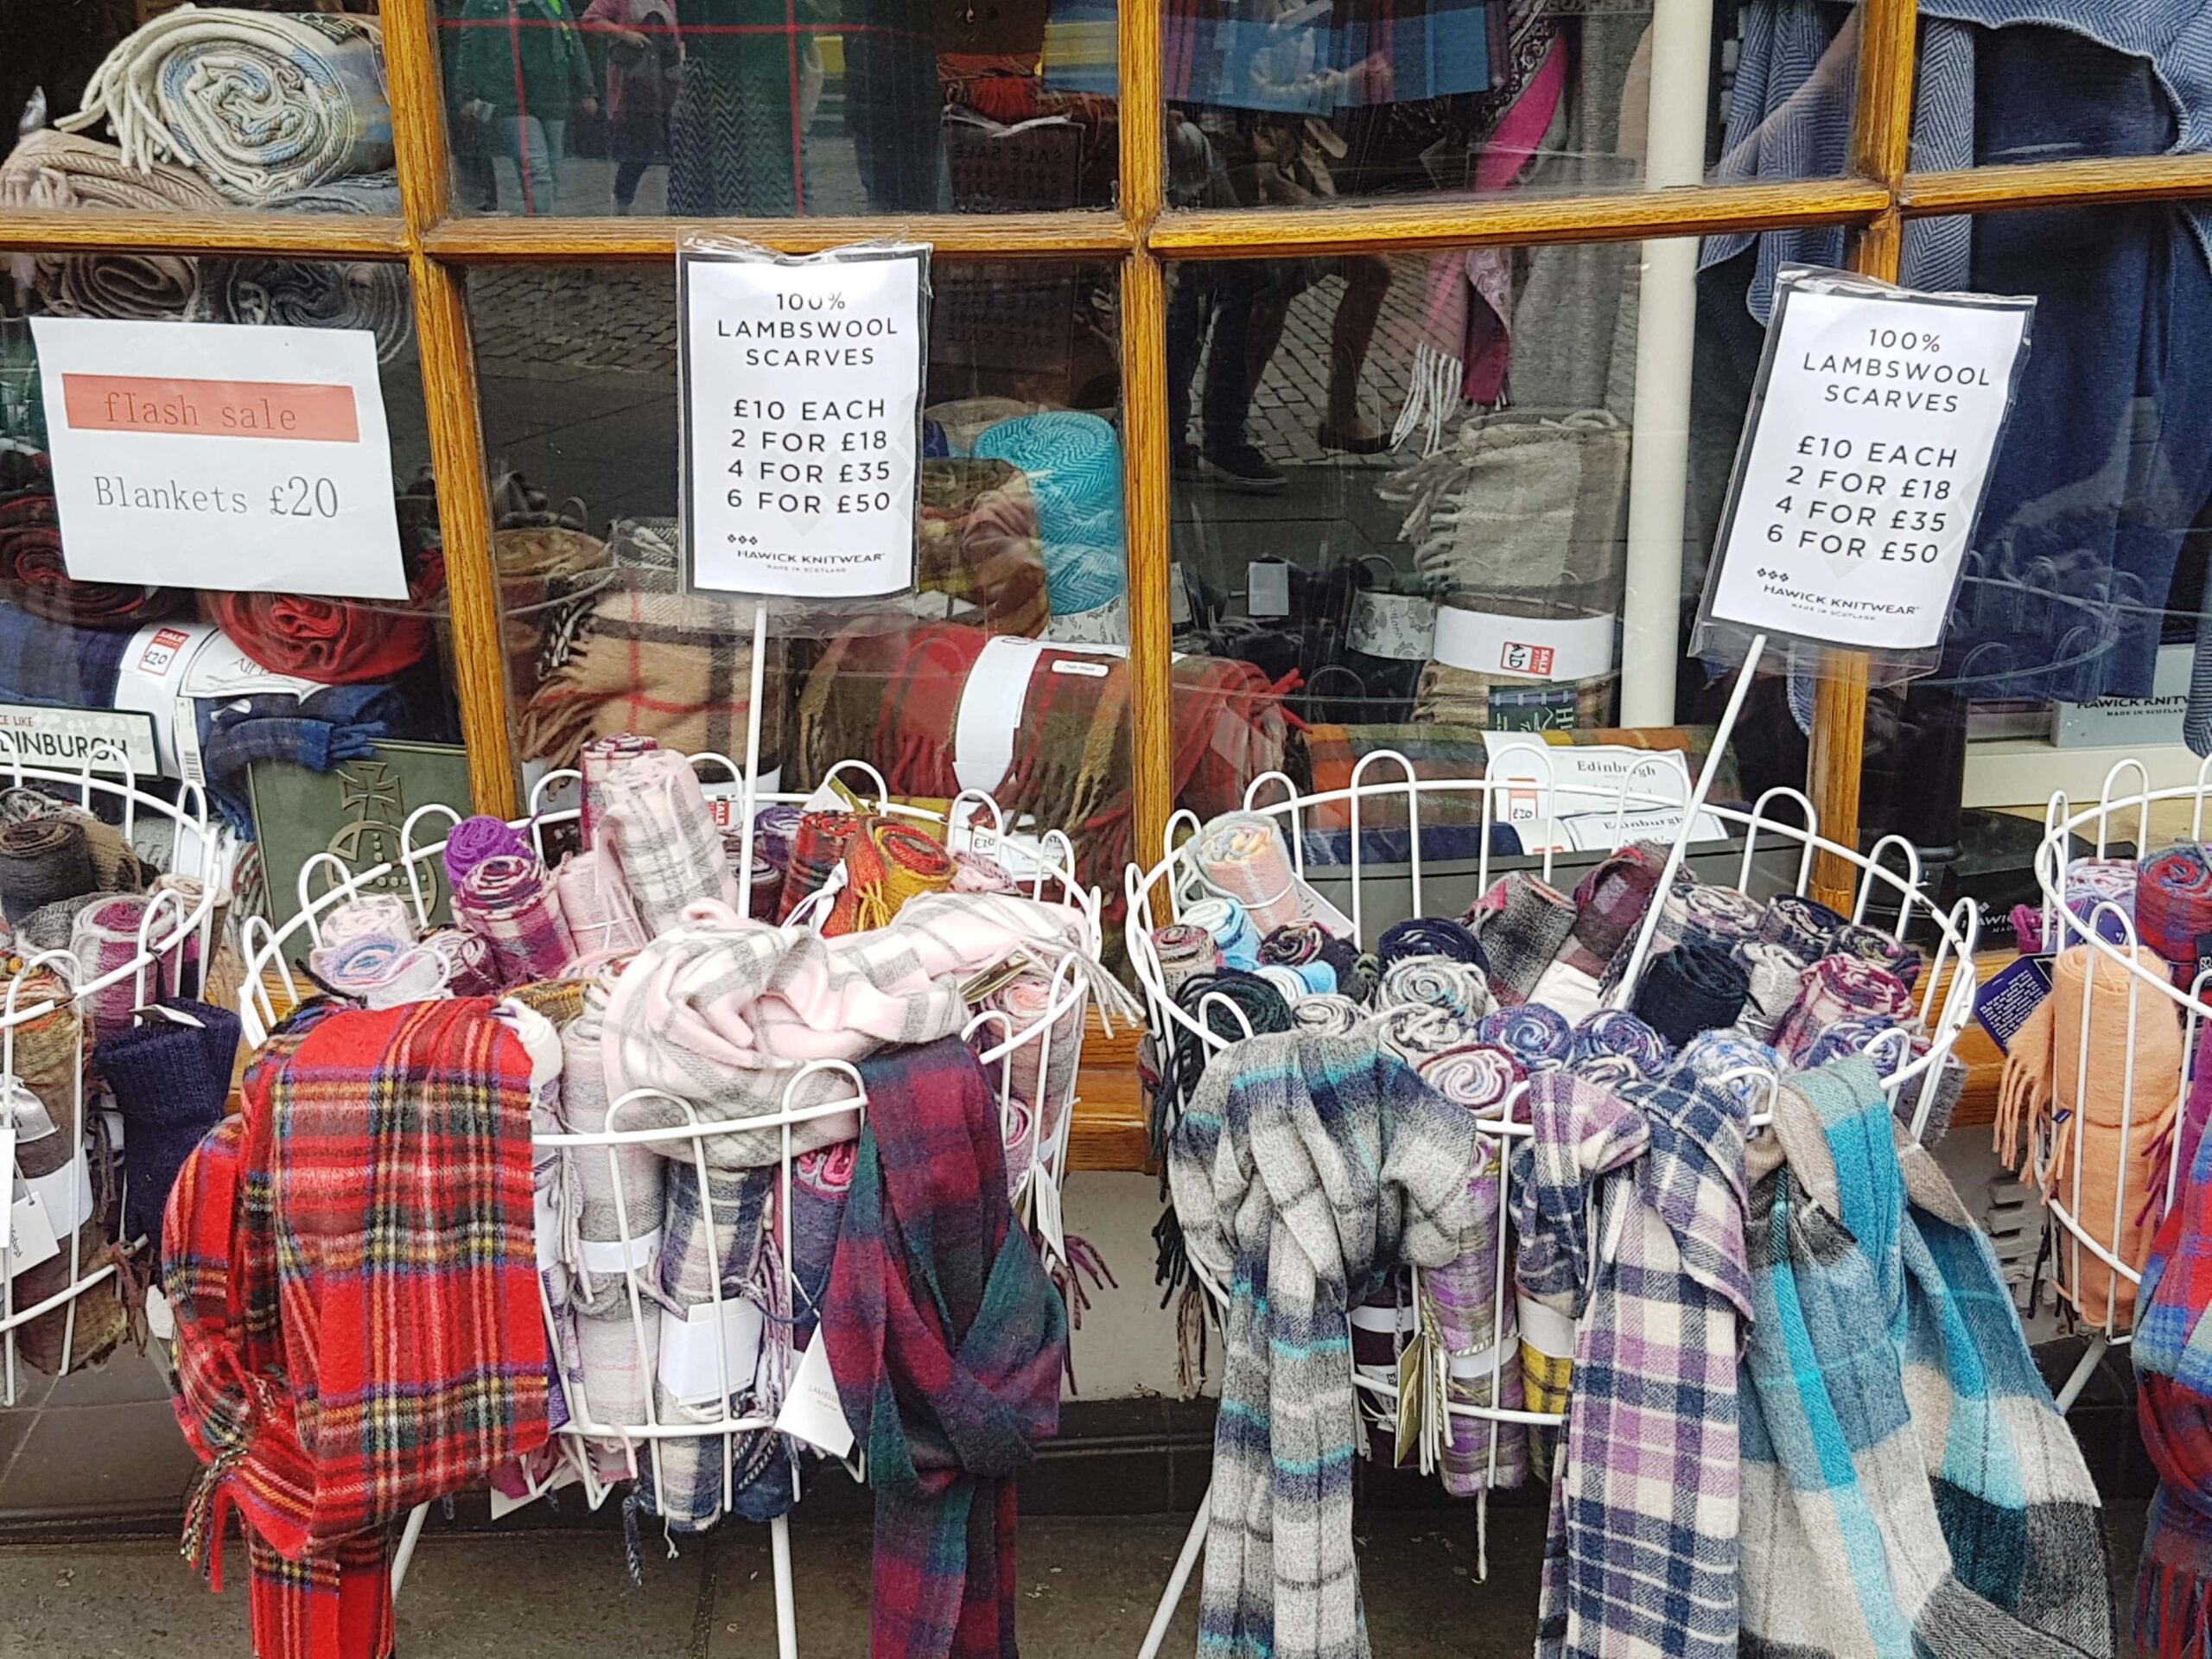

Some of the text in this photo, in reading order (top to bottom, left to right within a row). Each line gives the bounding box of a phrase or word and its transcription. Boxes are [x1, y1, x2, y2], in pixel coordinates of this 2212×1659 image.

[776, 293, 845, 311] 100%
[718, 317, 898, 339] LAMBSWOOL
[1870, 328, 1940, 353] 100%
[746, 347, 874, 367] SCARVES
[1803, 353, 1991, 385] LAMBSWOOL
[104, 392, 297, 430] flash sale
[734, 398, 884, 422] £10 EACH
[1824, 384, 1958, 413] SCARVES
[731, 429, 887, 453] 2 FOR £18
[1796, 435, 1957, 468] £10 EACH
[728, 459, 890, 484] 4 FOR £35
[1786, 465, 1951, 500] 2 FOR £18
[93, 476, 338, 518] Blankets £20
[727, 488, 890, 514] 6 FOR £50
[1775, 495, 1947, 532] 4 FOR £35
[1767, 524, 1938, 563] 6 FOR £50
[737, 550, 883, 564] HAWICK KNITWEAR
[1764, 584, 1916, 615] HAWICK KNITWEAR
[158, 631, 187, 643] SALE
[143, 651, 168, 665] £20
[1541, 649, 1551, 674] SALE
[13, 715, 34, 728] LIKE
[1512, 808, 1533, 820] £20
